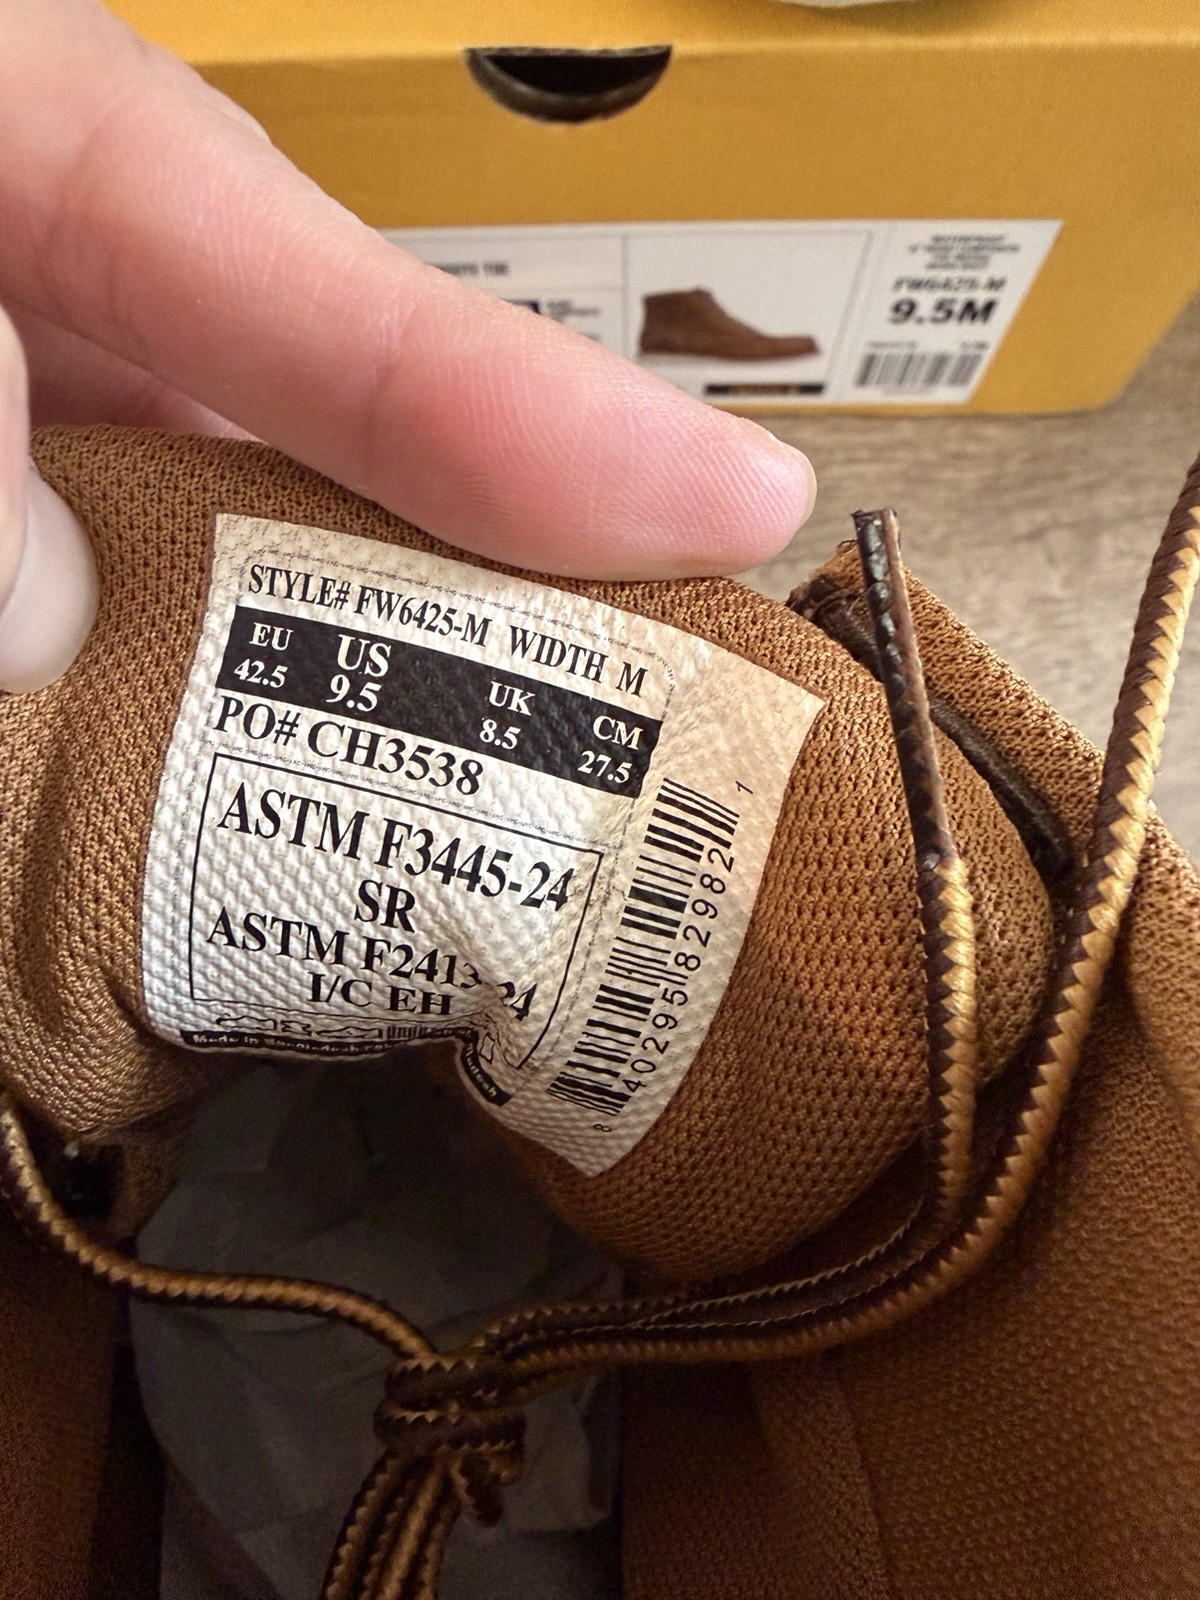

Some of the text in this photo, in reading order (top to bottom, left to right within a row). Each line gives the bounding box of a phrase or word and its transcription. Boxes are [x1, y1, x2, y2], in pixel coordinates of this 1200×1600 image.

[889, 298, 998, 325] 9.5M
[249, 564, 648, 697] STYLE# FW6425-M WIDTH M
[249, 622, 644, 750] EU US UK CM
[213, 695, 484, 796] PO# CH3538
[234, 658, 633, 783] 42.5 9.5 8.5 27.5
[217, 782, 575, 912] ASTM F3445-24
[206, 906, 350, 965] ASTM
[354, 879, 415, 933] SR
[593, 1122, 612, 1133] 8
[735, 780, 754, 795] 1
[308, 971, 454, 1016] I/C EH
